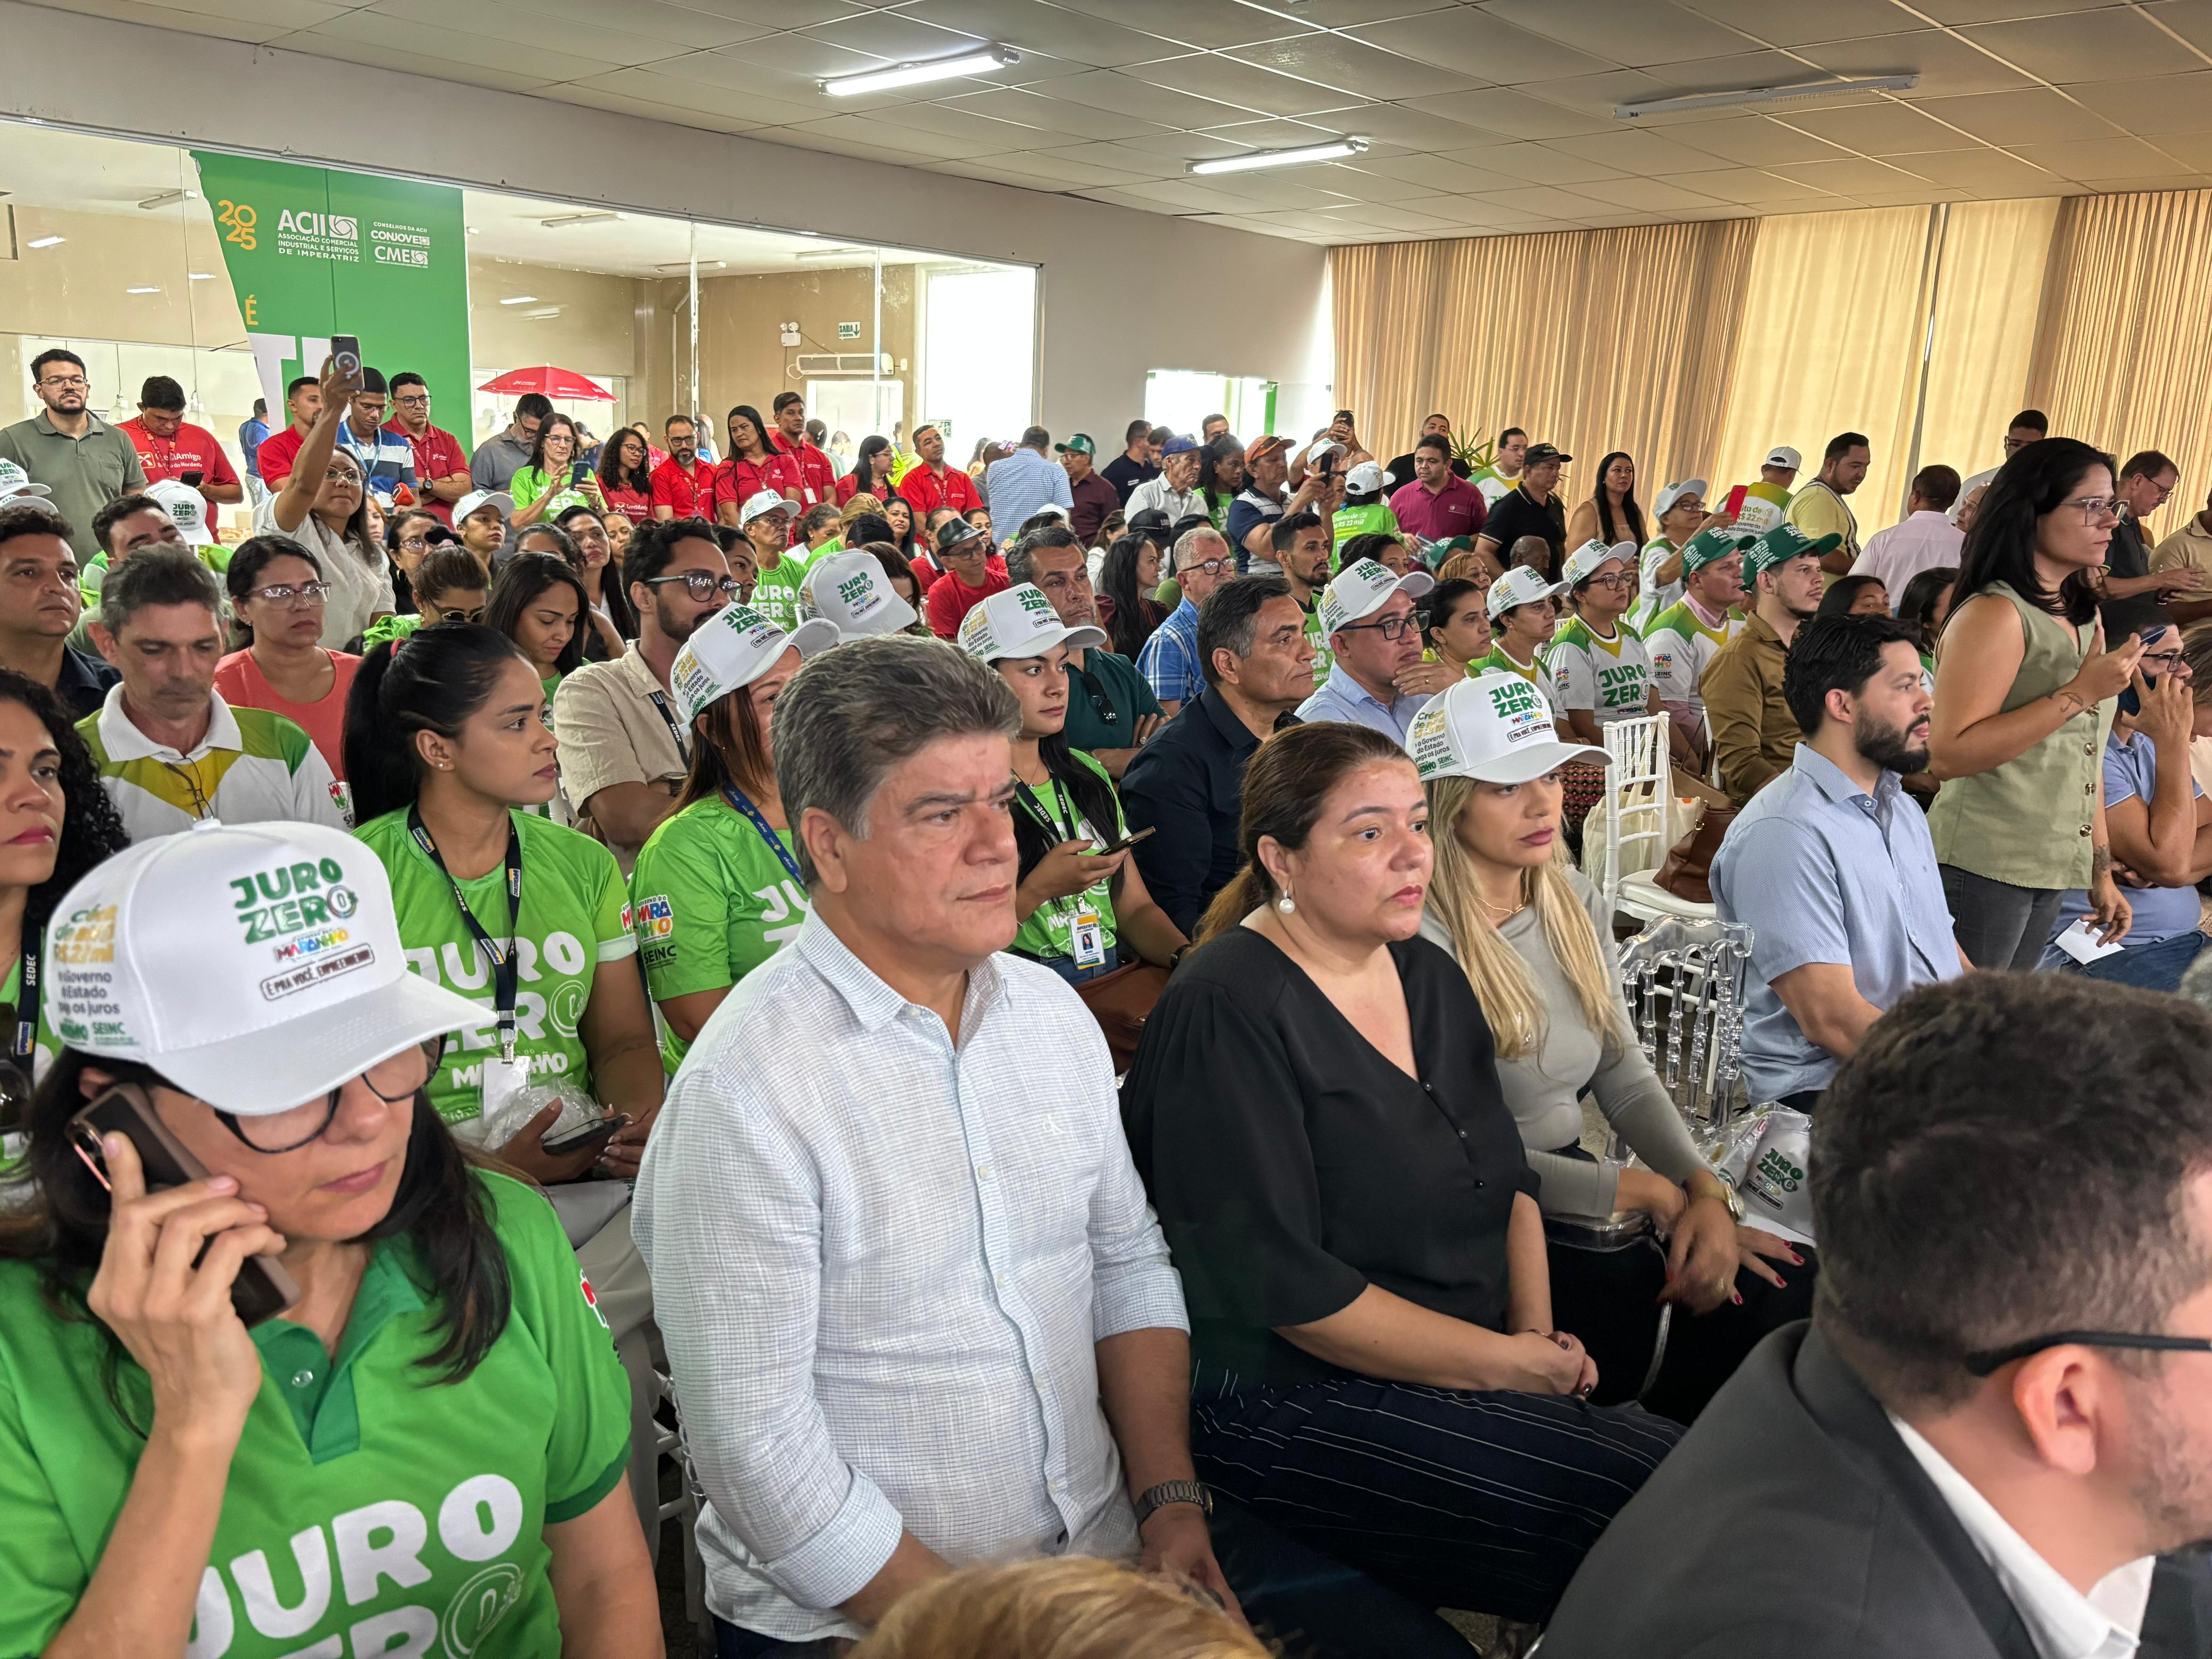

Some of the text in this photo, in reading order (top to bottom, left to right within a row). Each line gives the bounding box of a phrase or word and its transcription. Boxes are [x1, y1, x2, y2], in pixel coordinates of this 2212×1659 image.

[218, 200, 257, 227] 20
[278, 210, 326, 236] ACII
[226, 219, 257, 250] 25
[373, 222, 407, 230] CONSELHOS
[278, 233, 358, 247] ASSOCIAÇÃO COMERCIAL
[278, 240, 319, 250] INDUSTRIAL
[326, 246, 359, 255] SERVIÇOS
[371, 230, 420, 244] CONJOVE
[297, 250, 359, 262] IMPERATRIZ
[374, 246, 410, 263] CME
[245, 294, 258, 325] É
[837, 572, 868, 594] JURO
[841, 580, 874, 604] ZERO
[1598, 664, 1647, 688] JURO
[1489, 682, 1535, 704] JURO
[1494, 693, 1543, 718] ZERO
[670, 723, 682, 742] SEDEC
[1422, 733, 1445, 744] Governo
[1424, 741, 1443, 751] Estado
[1435, 745, 1451, 757] juros
[1437, 754, 1453, 764] SEINC
[1034, 803, 1051, 824] SEDEC
[1058, 794, 1068, 815] SEDEC
[230, 858, 343, 909] JURO
[238, 885, 359, 945] ZERO
[643, 944, 677, 965] SEINC
[26, 954, 36, 986] SEDEC
[266, 982, 274, 996] É
[274, 976, 294, 993] PRA
[1765, 1147, 1804, 1180] JURO
